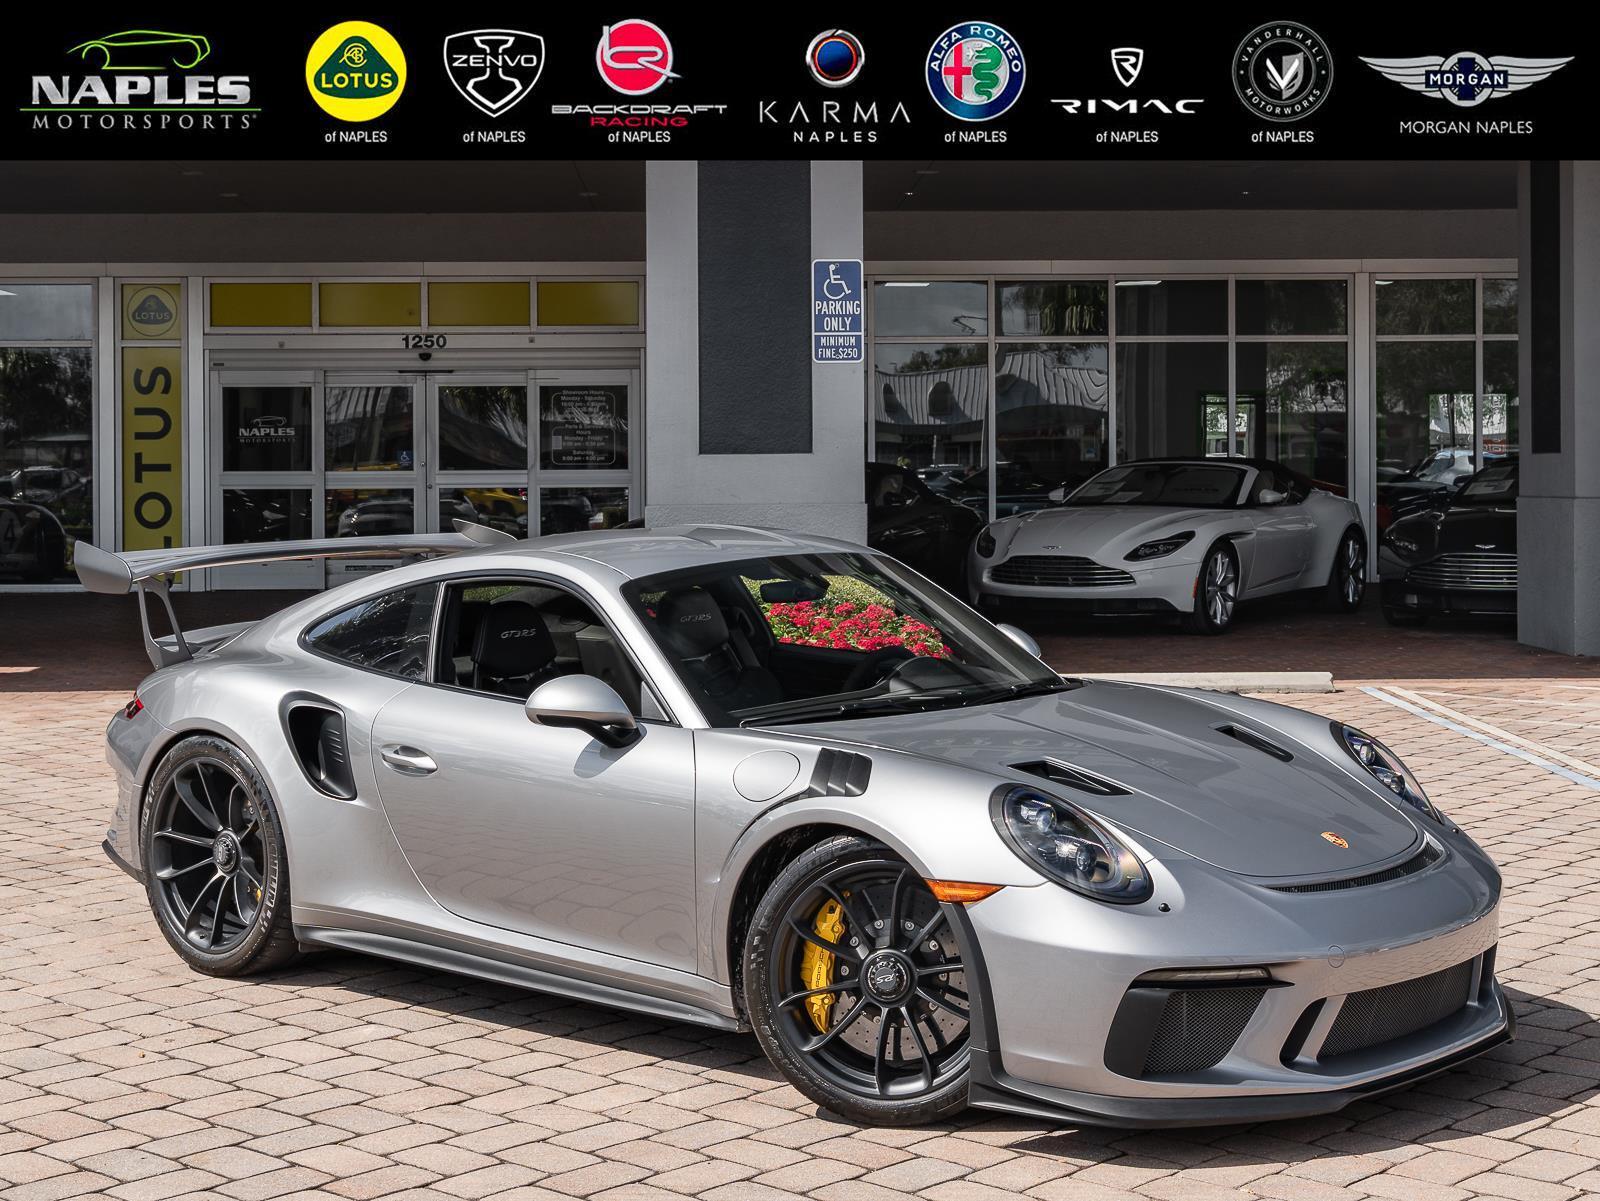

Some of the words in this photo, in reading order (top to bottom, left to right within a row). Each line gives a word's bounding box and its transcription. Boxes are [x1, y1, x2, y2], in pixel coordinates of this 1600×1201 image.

[815, 300, 861, 315] PARKING
[135, 311, 171, 320] LOTUS
[823, 317, 852, 331] ONLY
[401, 334, 448, 350] 1250
[820, 336, 856, 346] MINIMUM
[818, 348, 836, 359] FINE
[838, 348, 858, 359] $250
[239, 427, 296, 437] NAPLES
